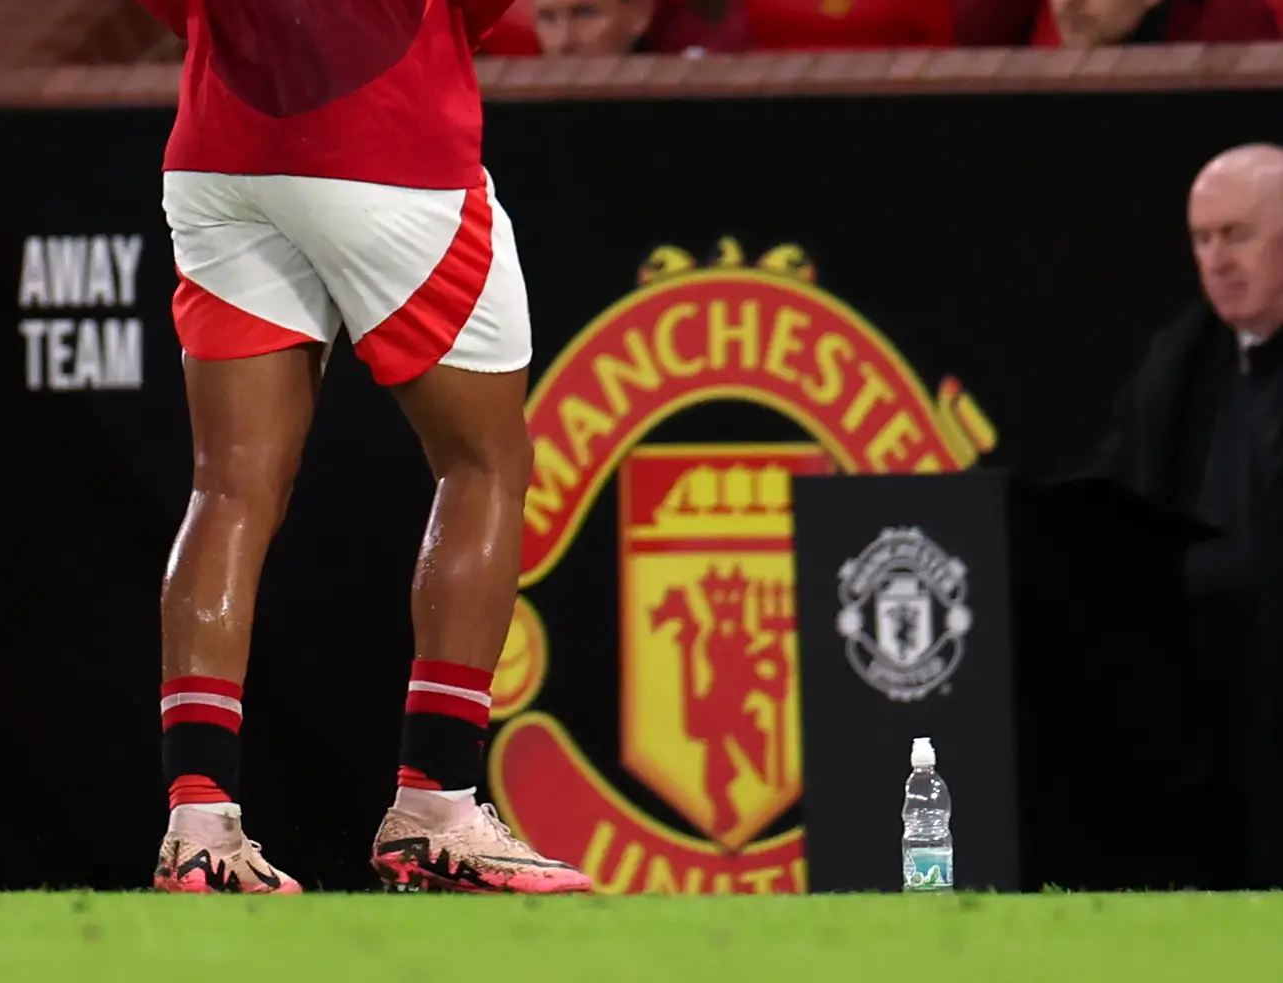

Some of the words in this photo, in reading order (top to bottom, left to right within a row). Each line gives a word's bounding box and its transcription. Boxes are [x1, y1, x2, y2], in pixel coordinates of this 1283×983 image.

[18, 234, 143, 308] AWAY
[18, 318, 143, 390] TEAM
[523, 299, 941, 534] MANCHESTE
